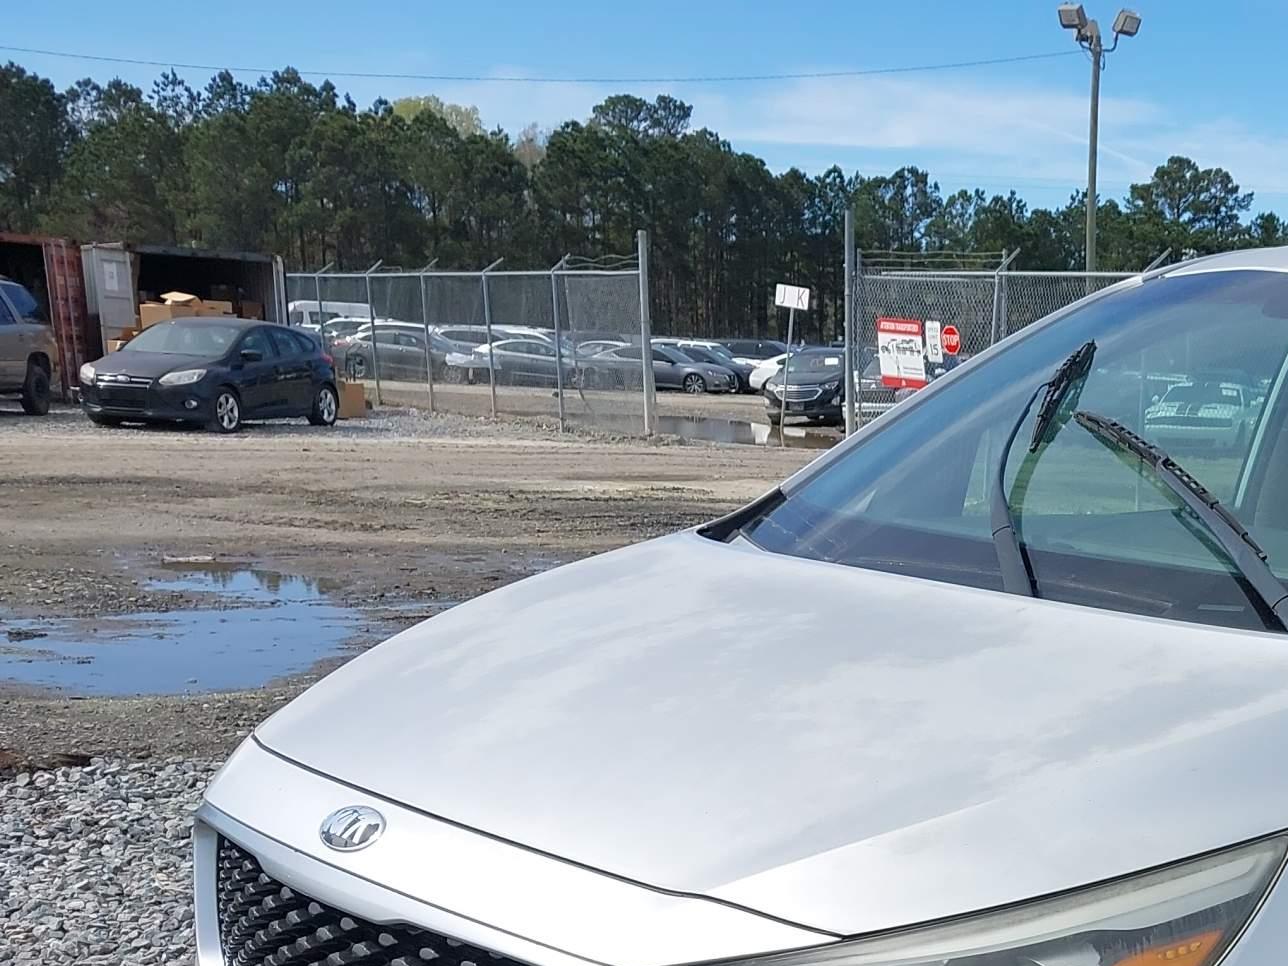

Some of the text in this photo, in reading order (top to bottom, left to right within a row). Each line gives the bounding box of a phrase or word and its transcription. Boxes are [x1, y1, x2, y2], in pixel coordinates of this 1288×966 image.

[780, 286, 806, 307] J K
[942, 334, 960, 346] STOP
[929, 343, 939, 356] 15
